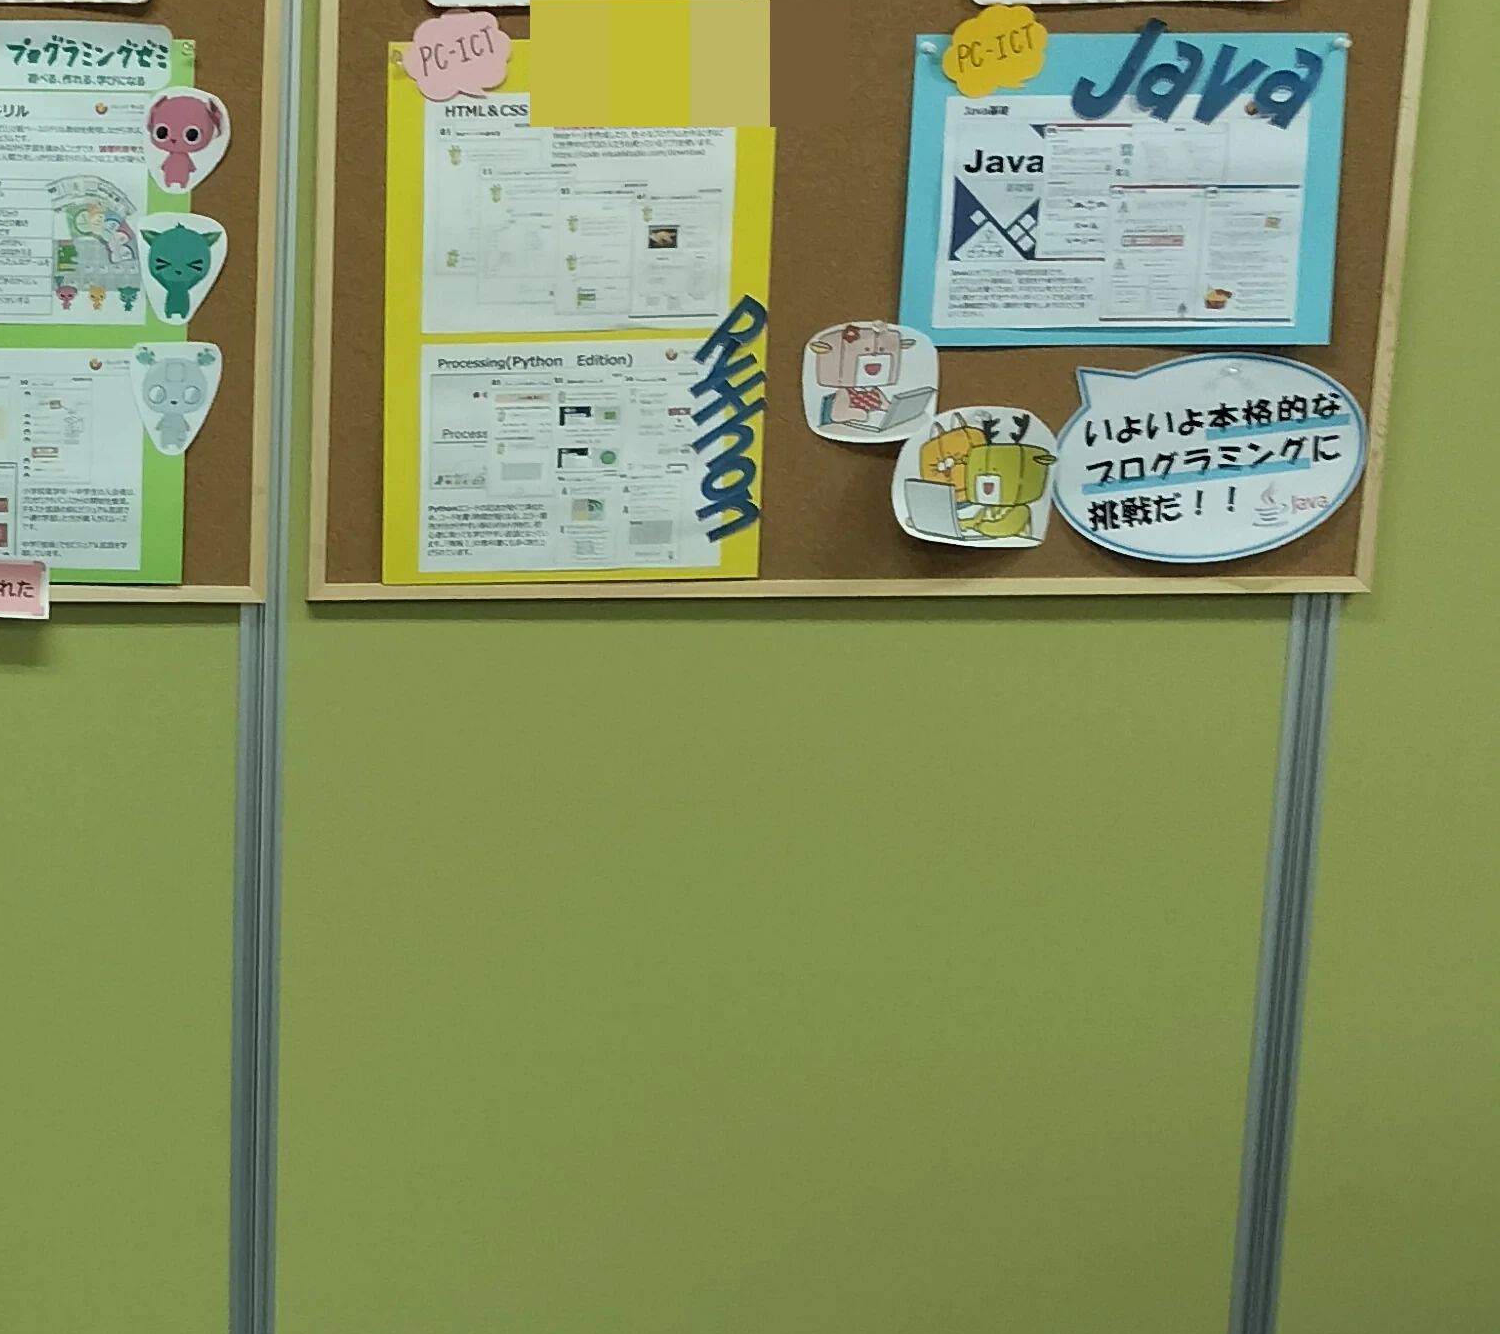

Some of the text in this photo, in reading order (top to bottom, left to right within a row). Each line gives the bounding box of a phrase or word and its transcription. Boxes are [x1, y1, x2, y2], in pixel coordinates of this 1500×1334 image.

[6, 34, 169, 69] プログラミングゼミ
[419, 25, 497, 77] PC-ICT
[957, 23, 1036, 73] PC-ICT
[1071, 17, 1323, 129] Java
[445, 104, 529, 118] HTML&CSS
[964, 149, 1044, 173] Java
[437, 353, 633, 371] Processing(Python Edition)
[1085, 392, 1342, 447] いよいよ本格的な
